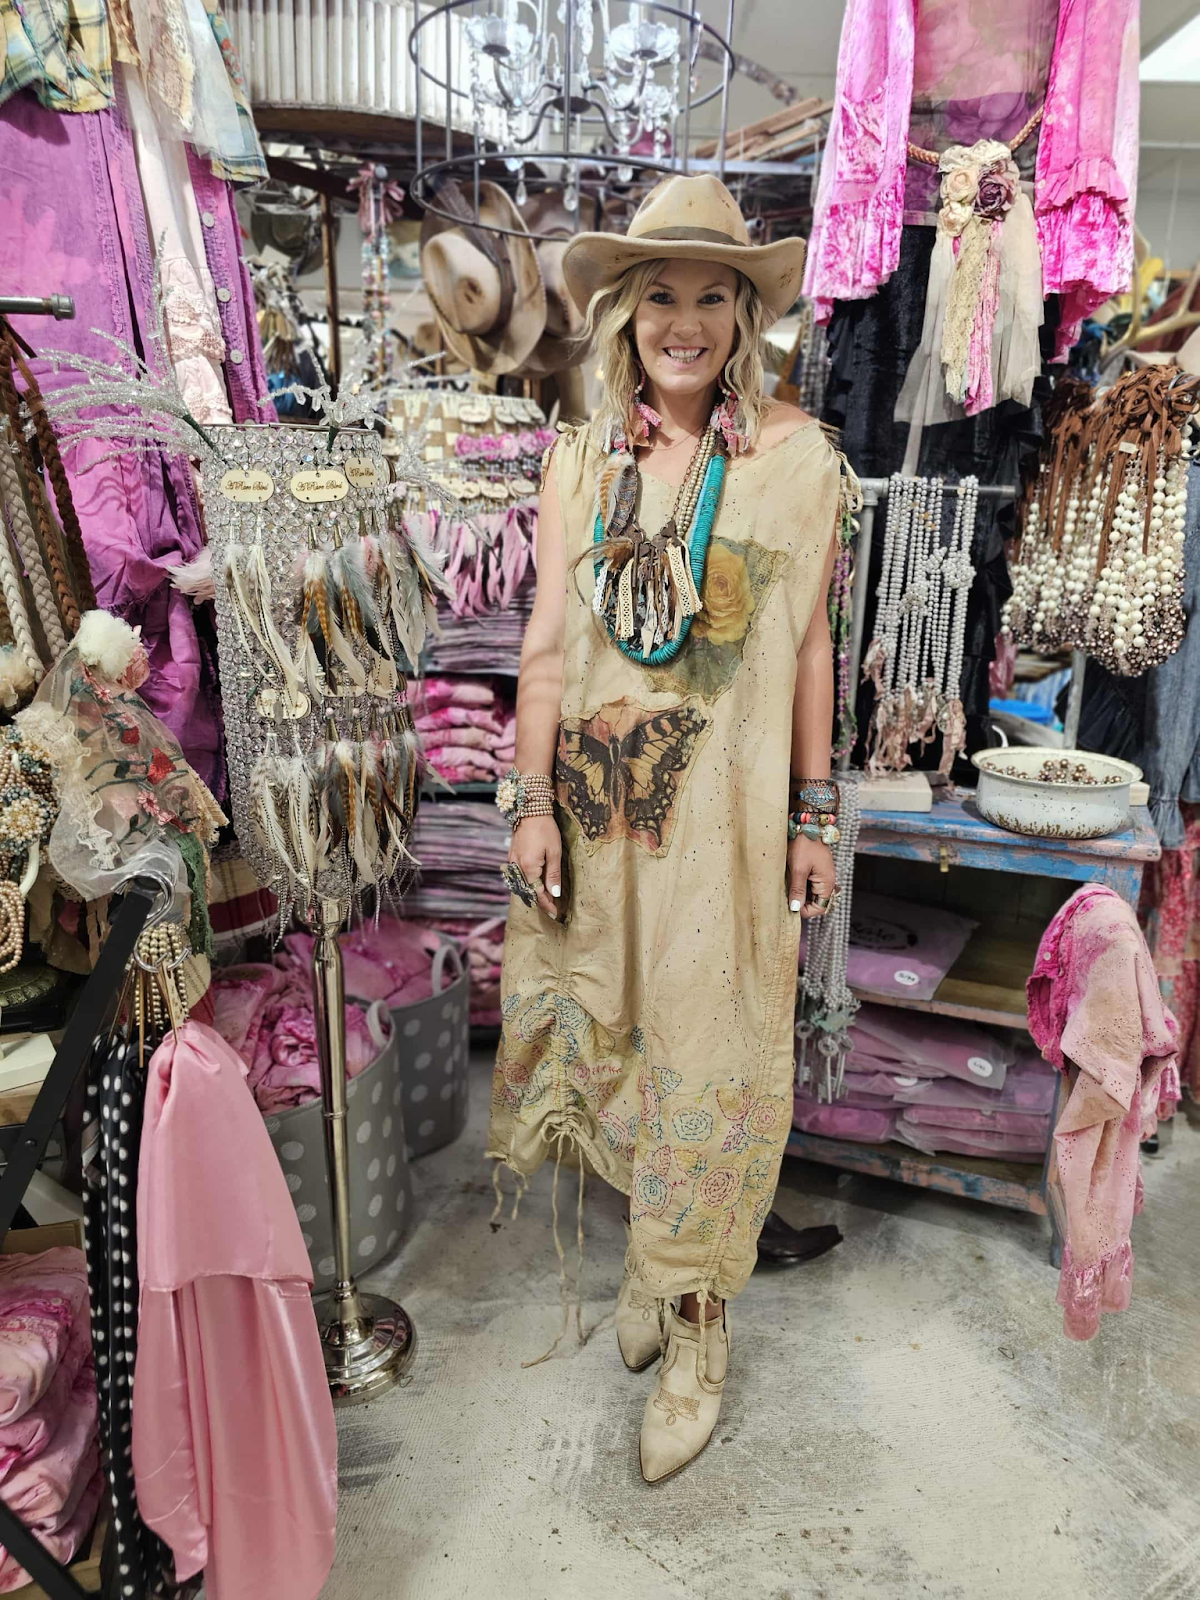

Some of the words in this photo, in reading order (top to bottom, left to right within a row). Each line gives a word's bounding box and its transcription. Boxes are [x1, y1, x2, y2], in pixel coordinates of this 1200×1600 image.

[233, 481, 251, 490] Rare
[252, 481, 269, 490] Bird
[305, 481, 325, 491] Rare
[326, 480, 343, 490] Bird
